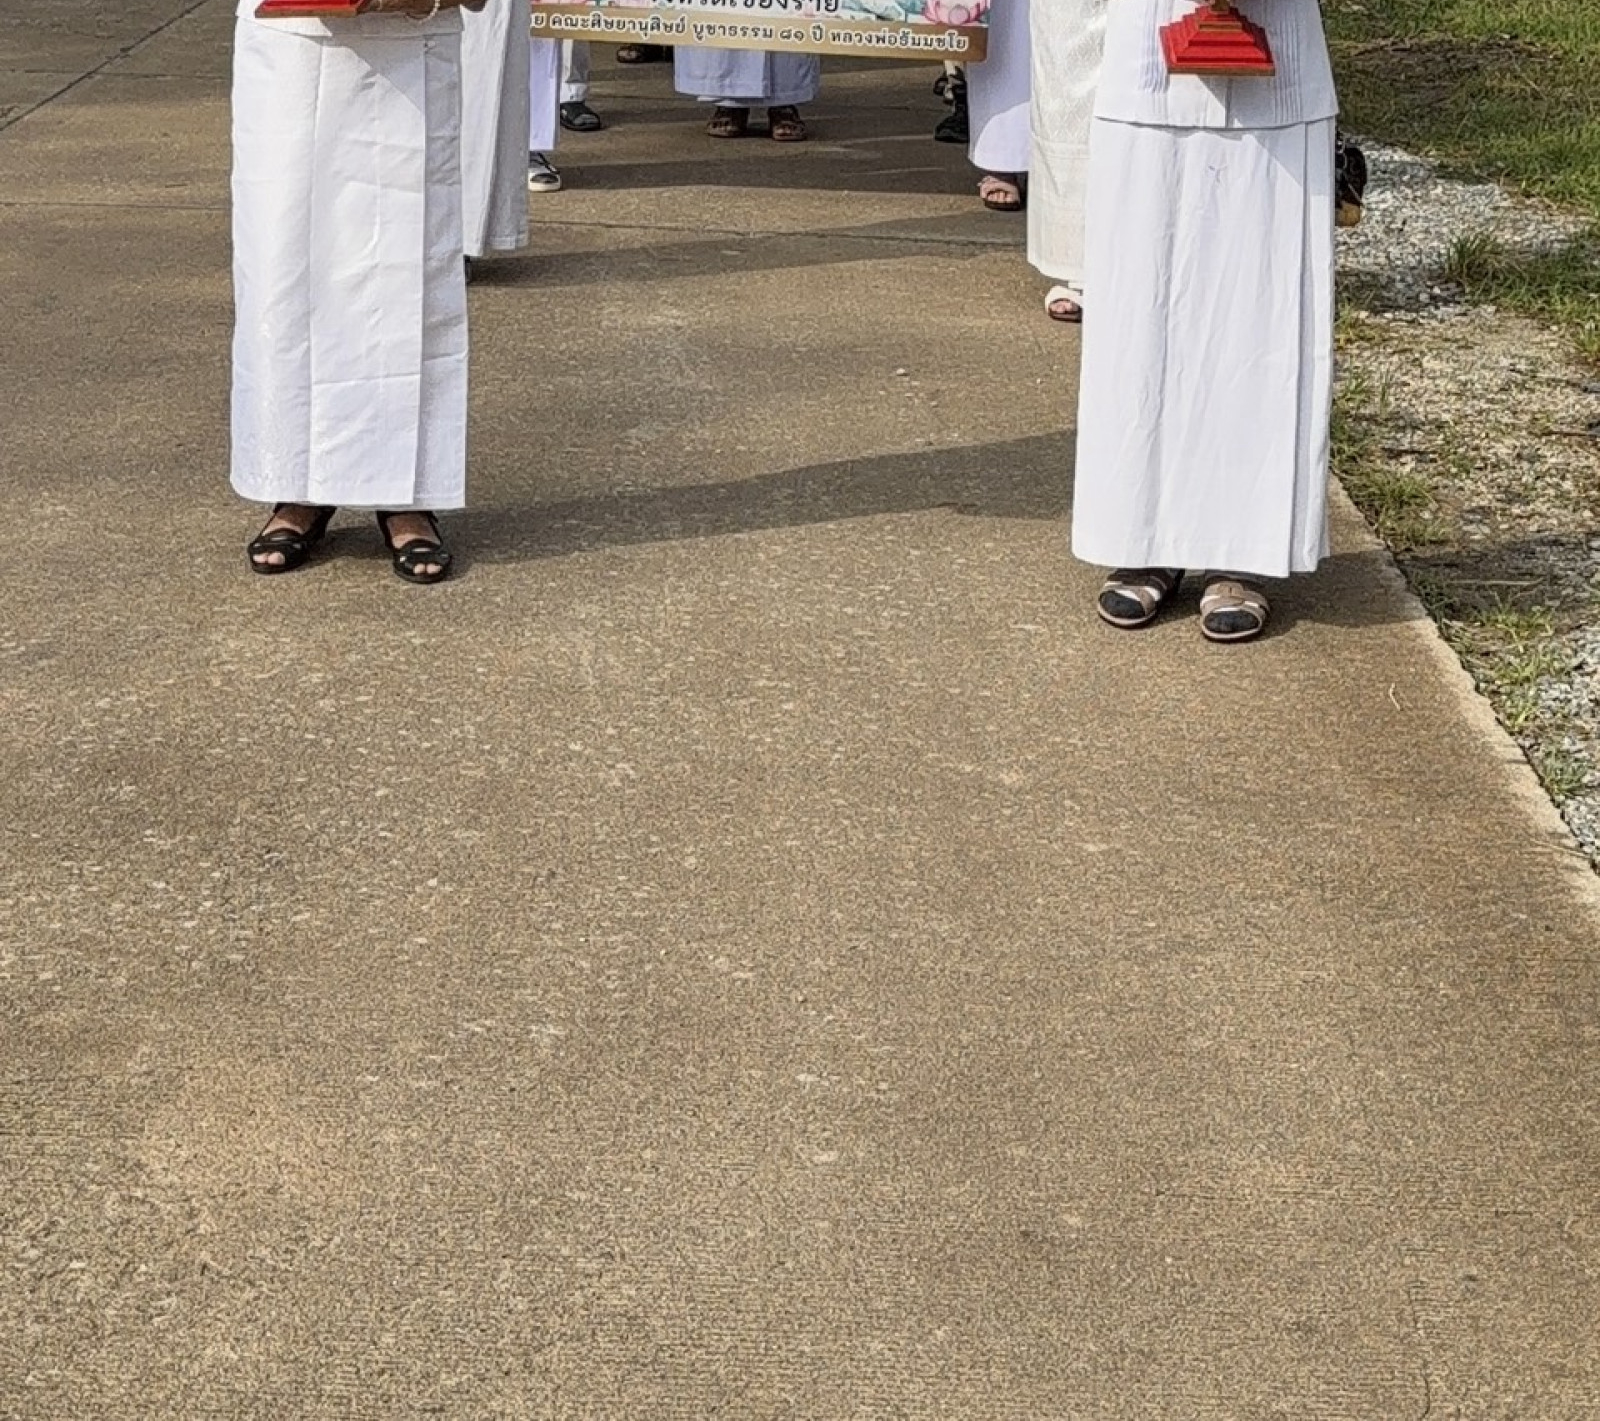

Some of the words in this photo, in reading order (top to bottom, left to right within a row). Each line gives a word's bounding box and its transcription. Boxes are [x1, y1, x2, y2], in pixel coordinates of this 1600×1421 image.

[551, 13, 686, 38] คณะศิษยานุศิษย์
[693, 23, 773, 41] บูชาธรรม
[812, 25, 823, 42] ปี
[831, 28, 967, 50] หลวงพ่อธัมมชโย
